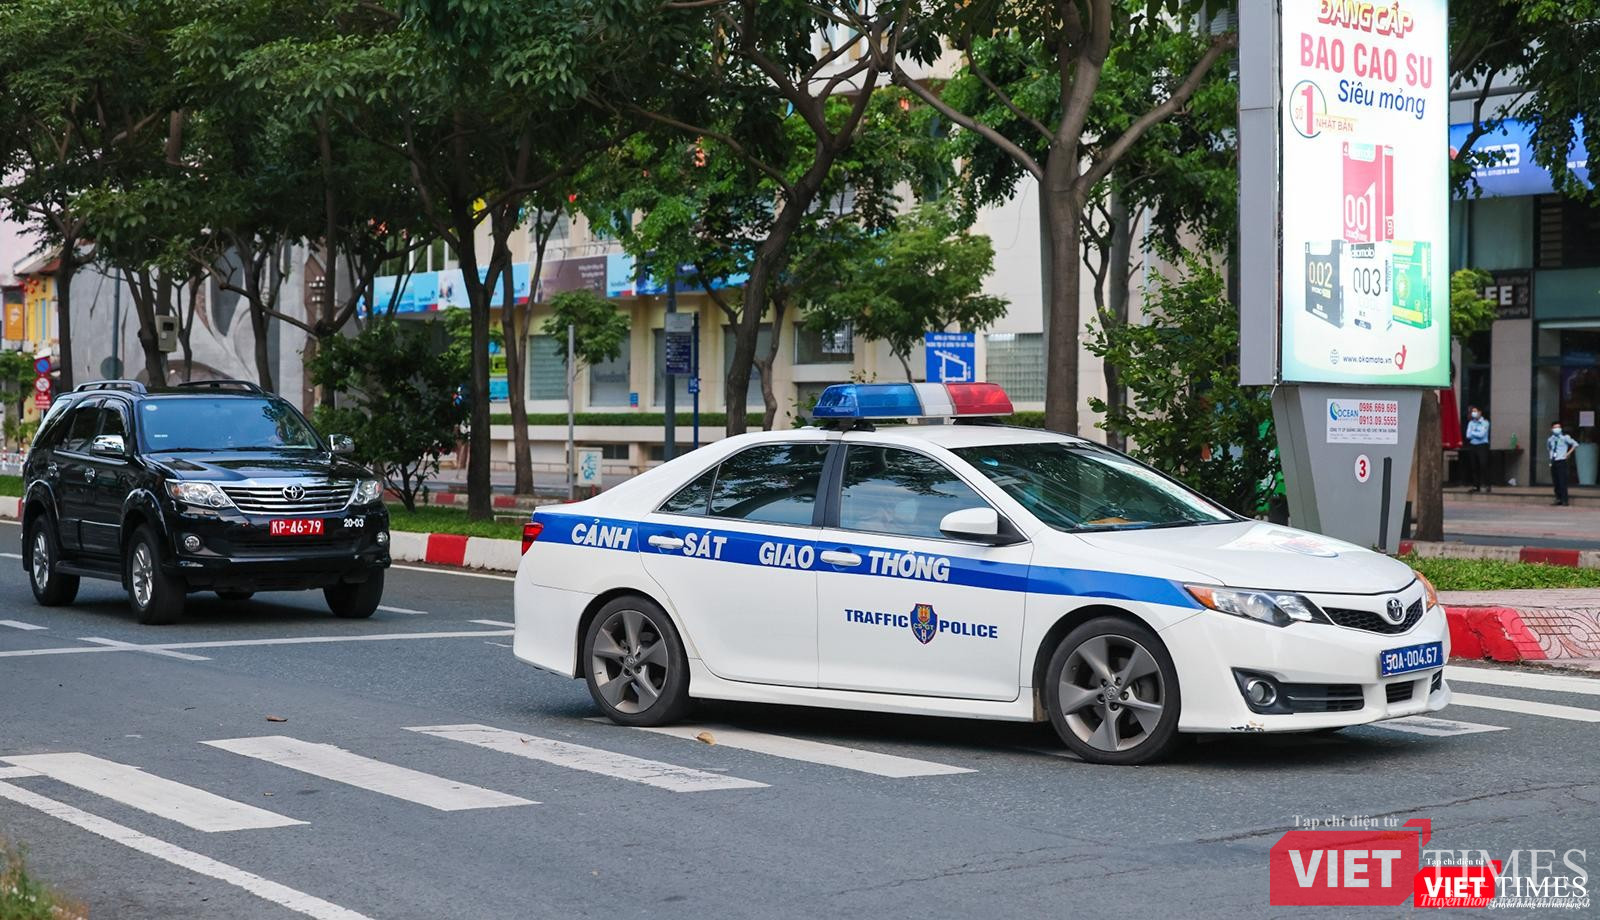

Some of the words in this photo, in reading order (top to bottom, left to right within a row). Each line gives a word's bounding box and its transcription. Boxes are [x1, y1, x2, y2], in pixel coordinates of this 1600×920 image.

[1300, 32, 1345, 74] BAO
[1353, 42, 1397, 83] CAO
[1405, 53, 1432, 89] SU
[1338, 79, 1374, 107] Siêu
[1379, 87, 1426, 120] mỏng
[1338, 409, 1359, 418] OCEAN
[1359, 415, 1397, 426] 0913.09.5555
[1359, 459, 1367, 478] 3
[271, 520, 322, 534] KP-46-79
[343, 518, 364, 527] 20-03
[571, 518, 632, 549] CẢNH
[682, 531, 727, 559] SÁT
[759, 541, 814, 569] GIAO
[869, 550, 950, 582] THÔNG
[845, 609, 908, 628] TRAFFIC
[939, 620, 998, 638] POLICE
